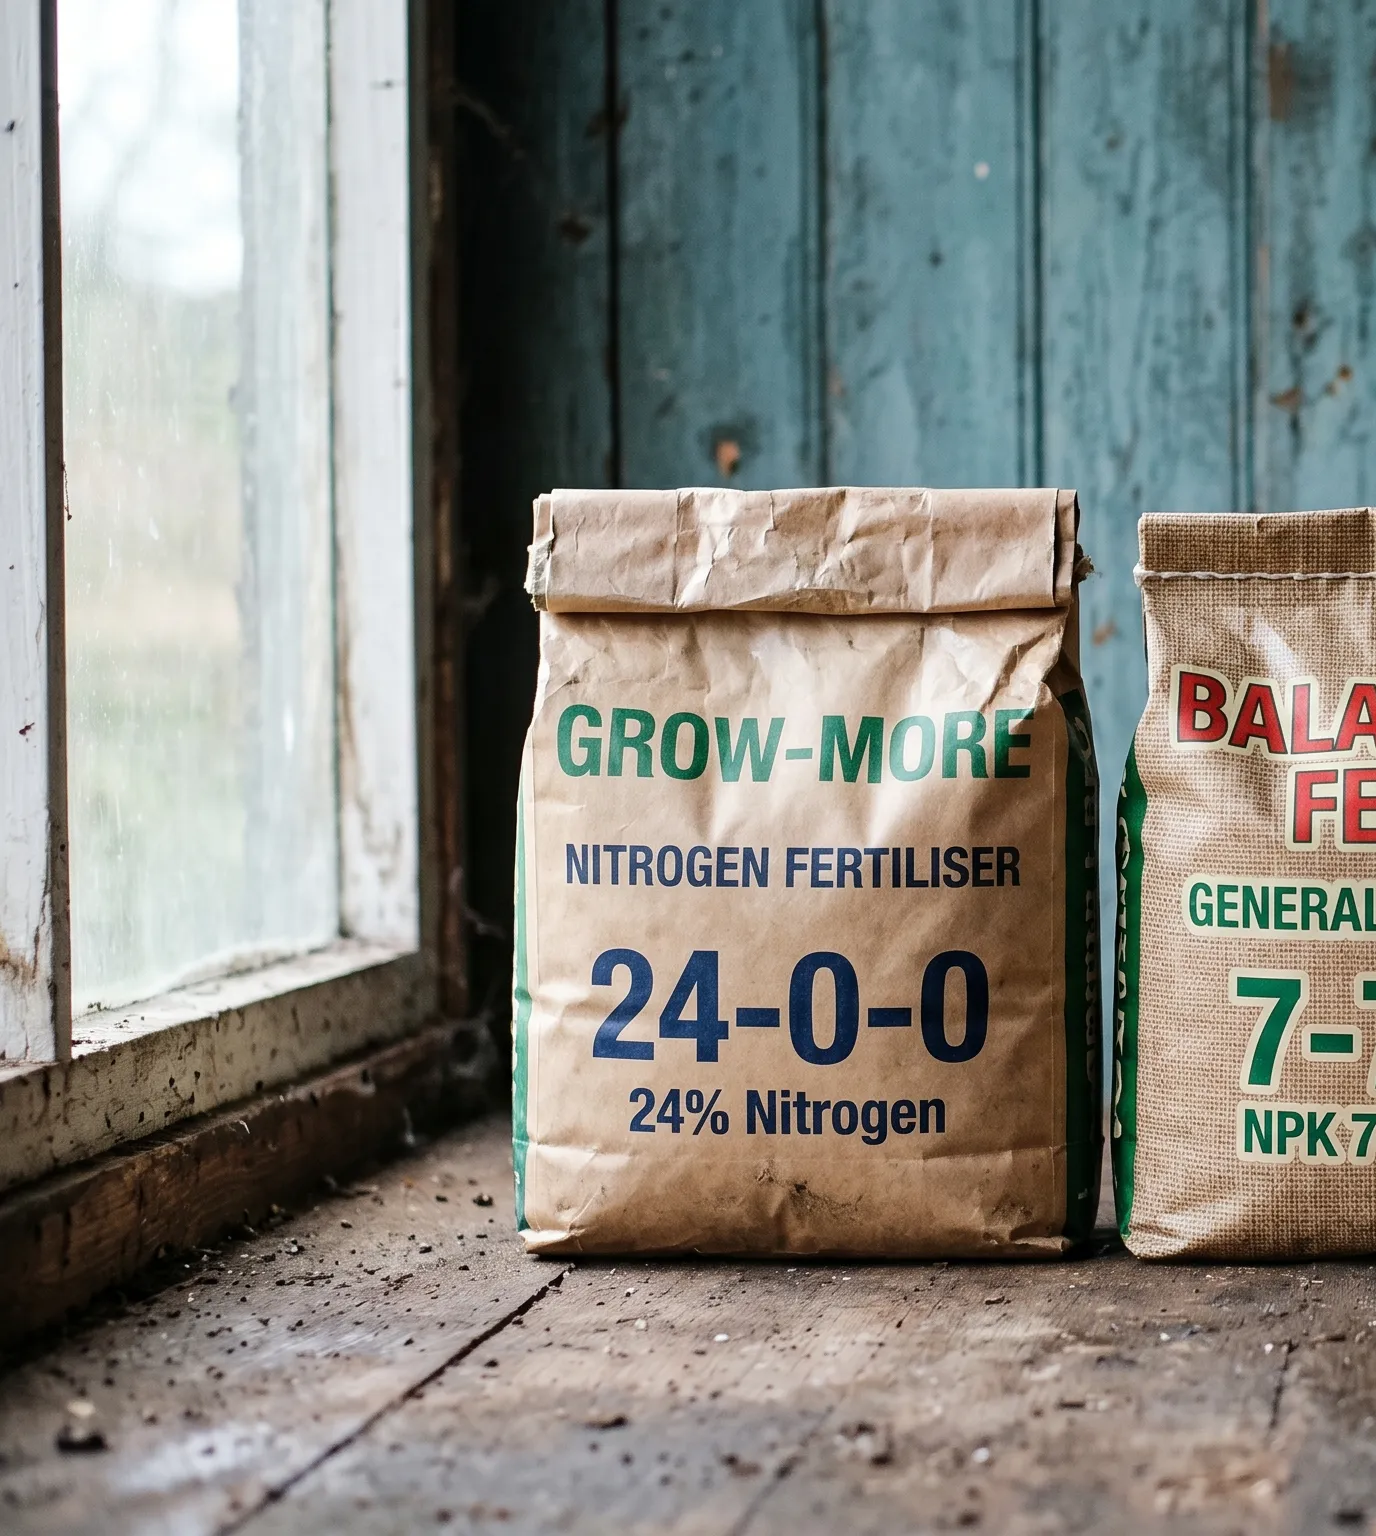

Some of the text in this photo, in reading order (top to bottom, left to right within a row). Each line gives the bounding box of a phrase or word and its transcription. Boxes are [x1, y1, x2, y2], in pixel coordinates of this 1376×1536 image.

[556, 703, 1035, 784] GROW-MORE
[565, 843, 1021, 889] NITROGEN FERTILISER
[591, 948, 990, 1066] 24-0-0
[629, 1087, 946, 1145] 24% Nitrogen
[1244, 1108, 1339, 1158] NPK
